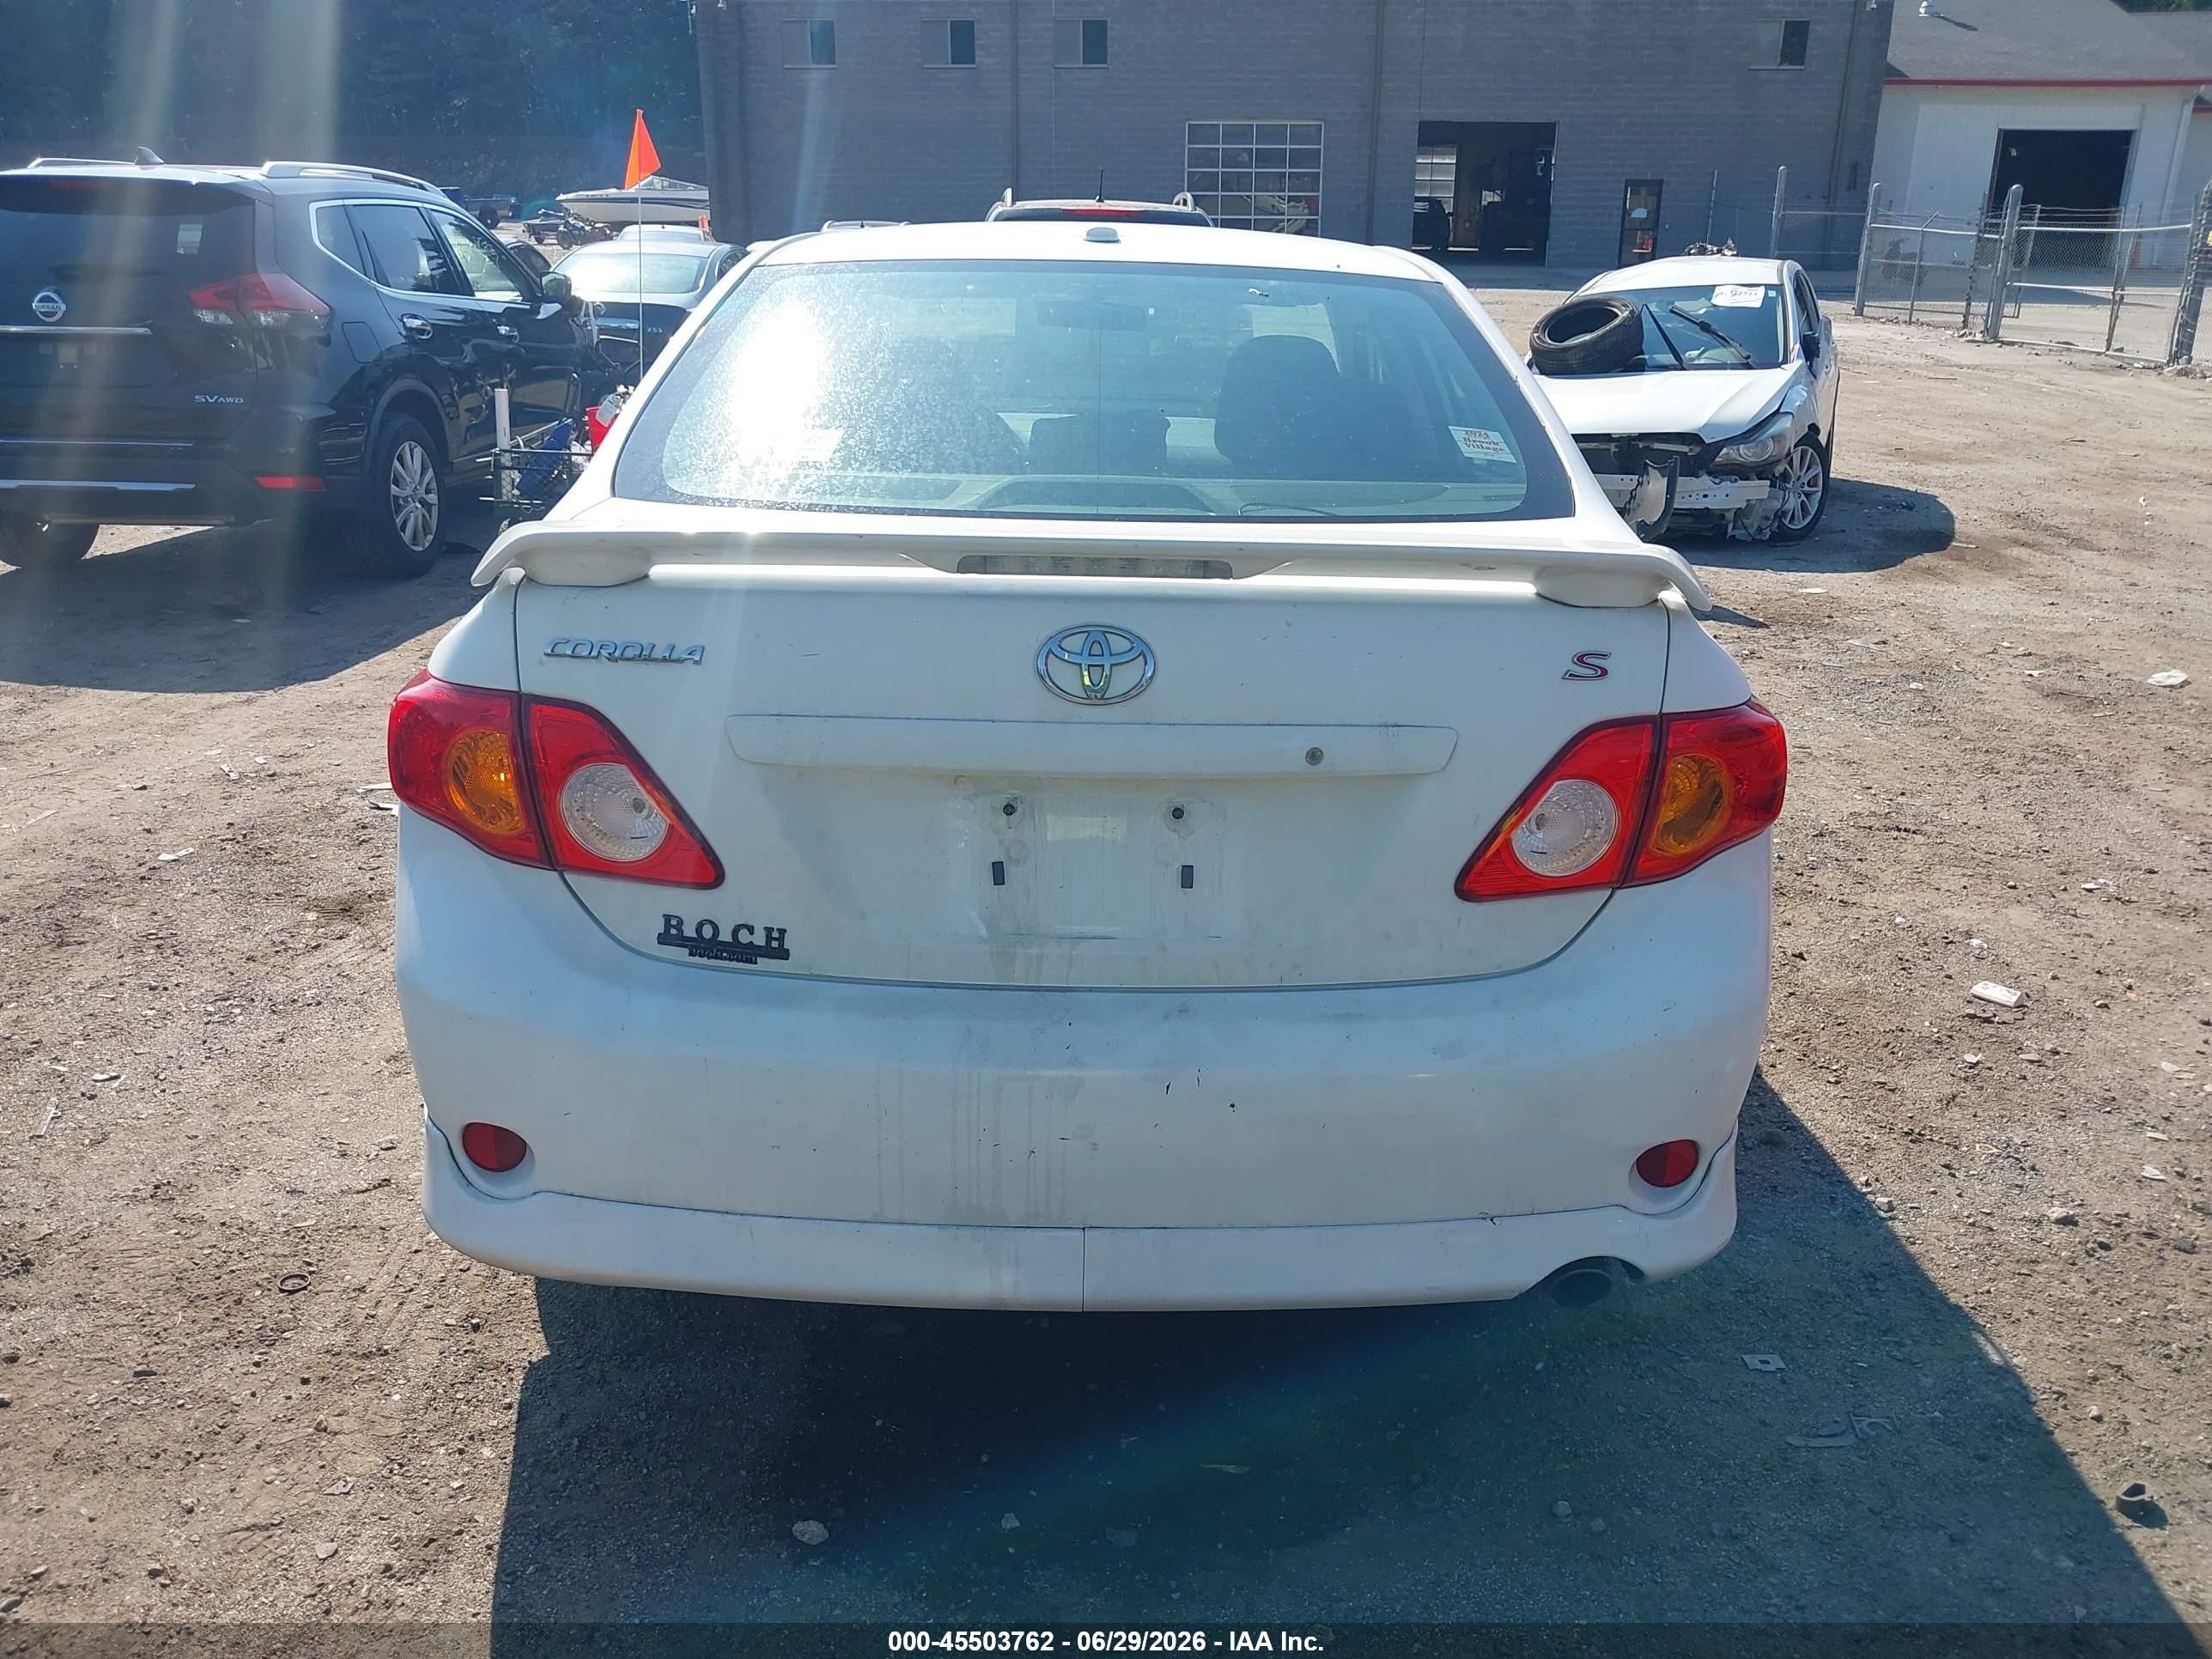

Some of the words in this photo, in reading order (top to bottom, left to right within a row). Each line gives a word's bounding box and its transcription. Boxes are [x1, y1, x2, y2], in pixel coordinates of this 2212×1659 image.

[544, 639, 705, 665] COROLLA
[1561, 650, 1613, 681] S
[662, 914, 787, 950] BOCH
